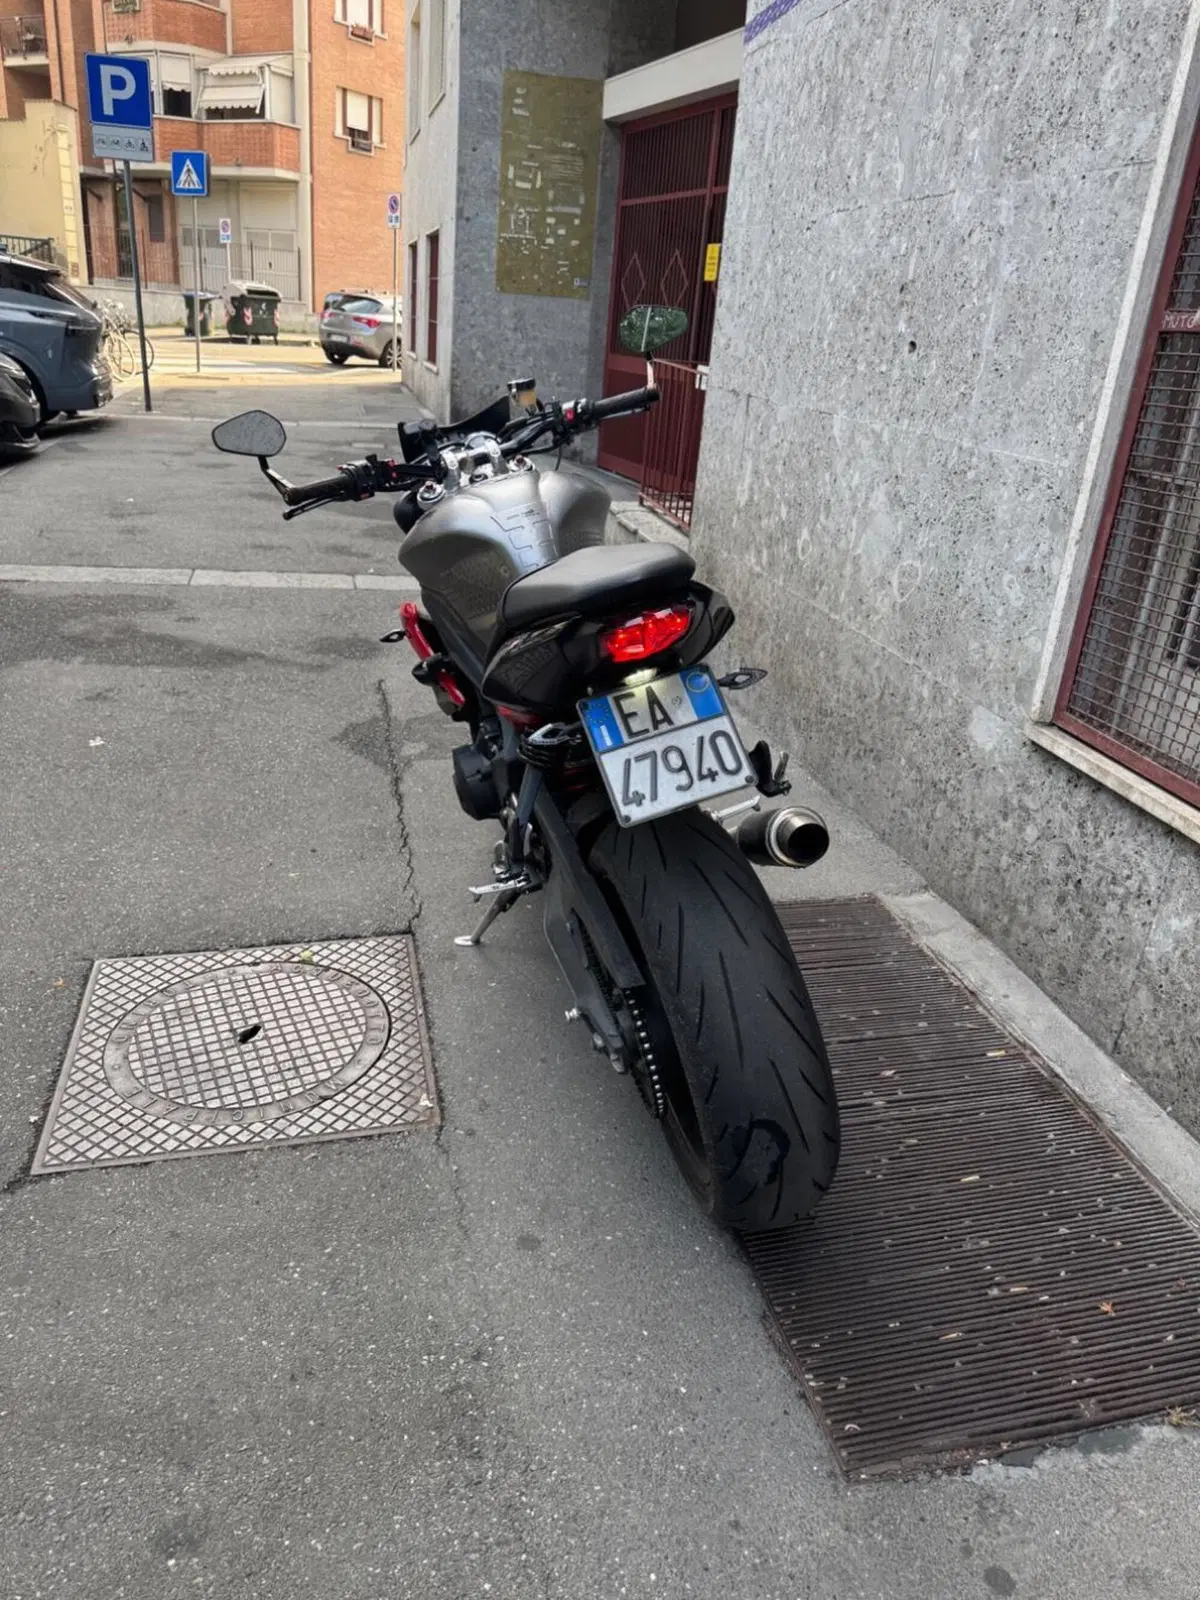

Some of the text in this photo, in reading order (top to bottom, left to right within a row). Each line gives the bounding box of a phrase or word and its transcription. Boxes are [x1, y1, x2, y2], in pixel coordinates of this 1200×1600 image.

[100, 65, 136, 115] P
[613, 686, 674, 738] EA
[621, 730, 743, 807] 47940
